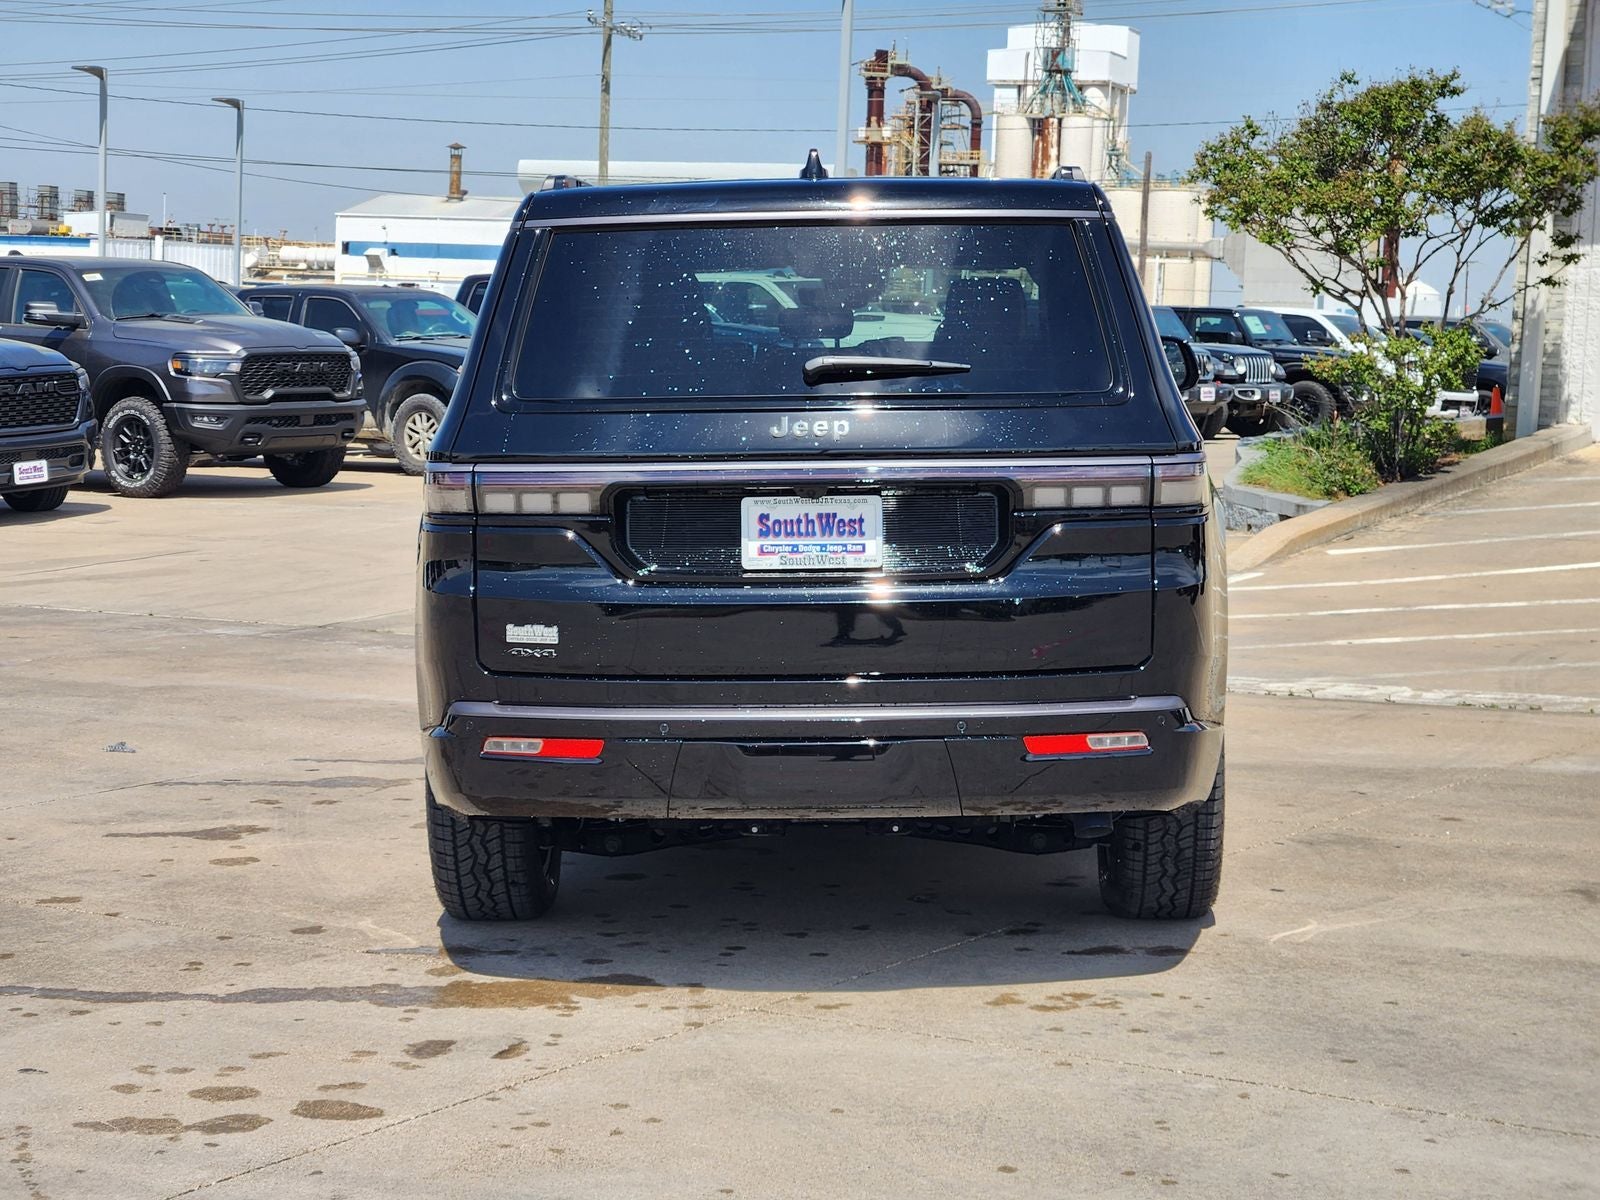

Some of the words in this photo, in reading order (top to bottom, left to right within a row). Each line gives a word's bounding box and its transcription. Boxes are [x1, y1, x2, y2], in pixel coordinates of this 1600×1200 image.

[769, 416, 850, 441] Jeep
[763, 544, 792, 553] Chrysler
[798, 544, 820, 554] Dodge
[847, 544, 863, 552] Ram
